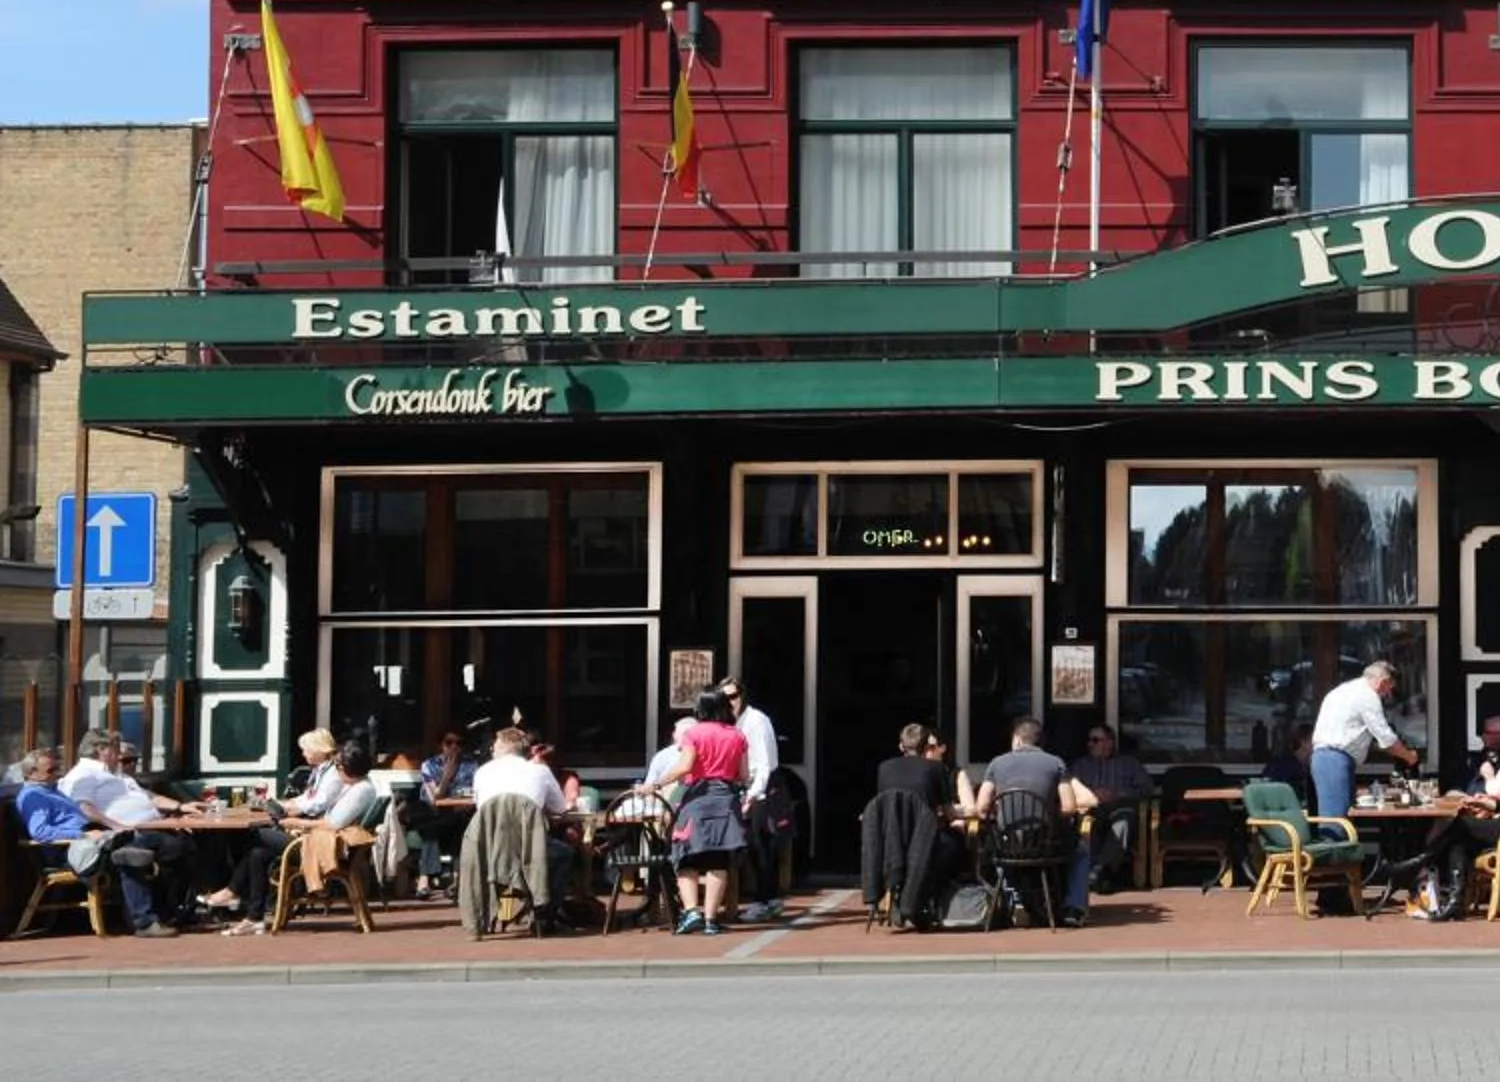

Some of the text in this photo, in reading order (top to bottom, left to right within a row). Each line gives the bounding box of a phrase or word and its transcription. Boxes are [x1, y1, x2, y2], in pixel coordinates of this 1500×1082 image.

[291, 296, 706, 339] Estaminet
[345, 368, 552, 416] Corsendonk bier
[1095, 361, 1379, 400] PRINS
